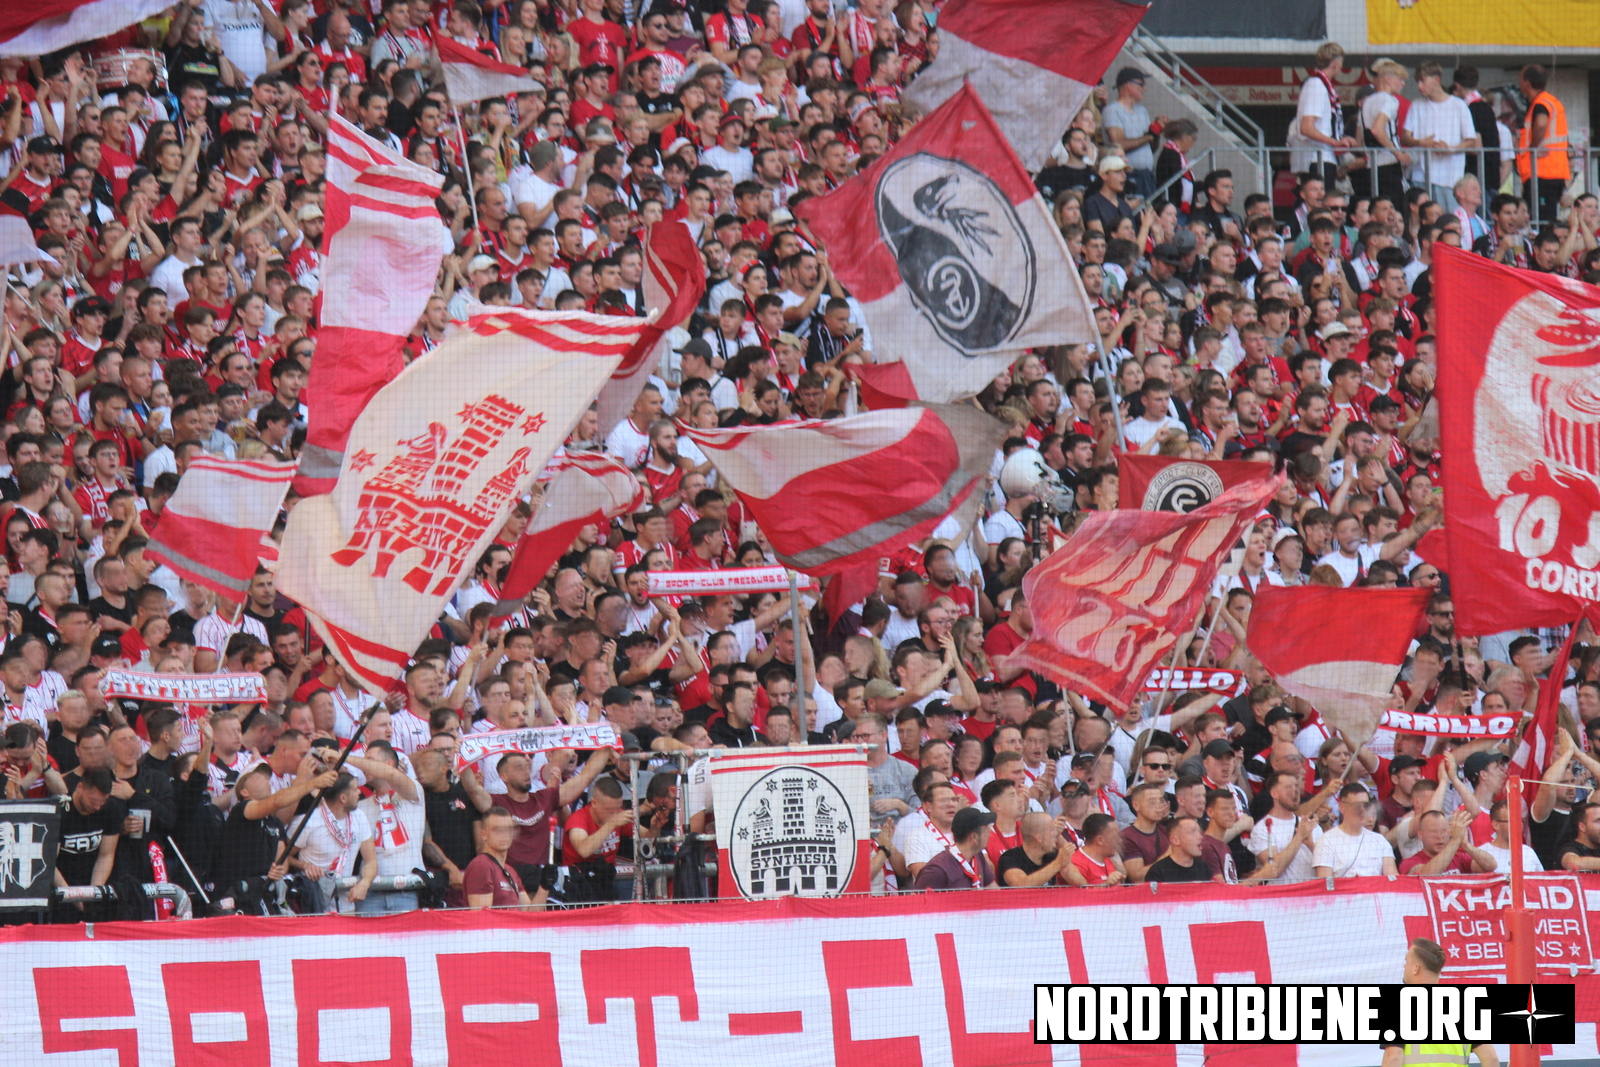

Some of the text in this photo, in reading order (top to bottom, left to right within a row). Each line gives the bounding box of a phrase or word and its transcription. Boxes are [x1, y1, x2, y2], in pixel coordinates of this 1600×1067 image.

[1493, 492, 1561, 558] 10
[109, 672, 259, 699] SYNTHESIA
[751, 853, 837, 869] SYNTHESIA
[1442, 916, 1581, 937] FÜR IMER
[1465, 941, 1564, 960] BEI NS
